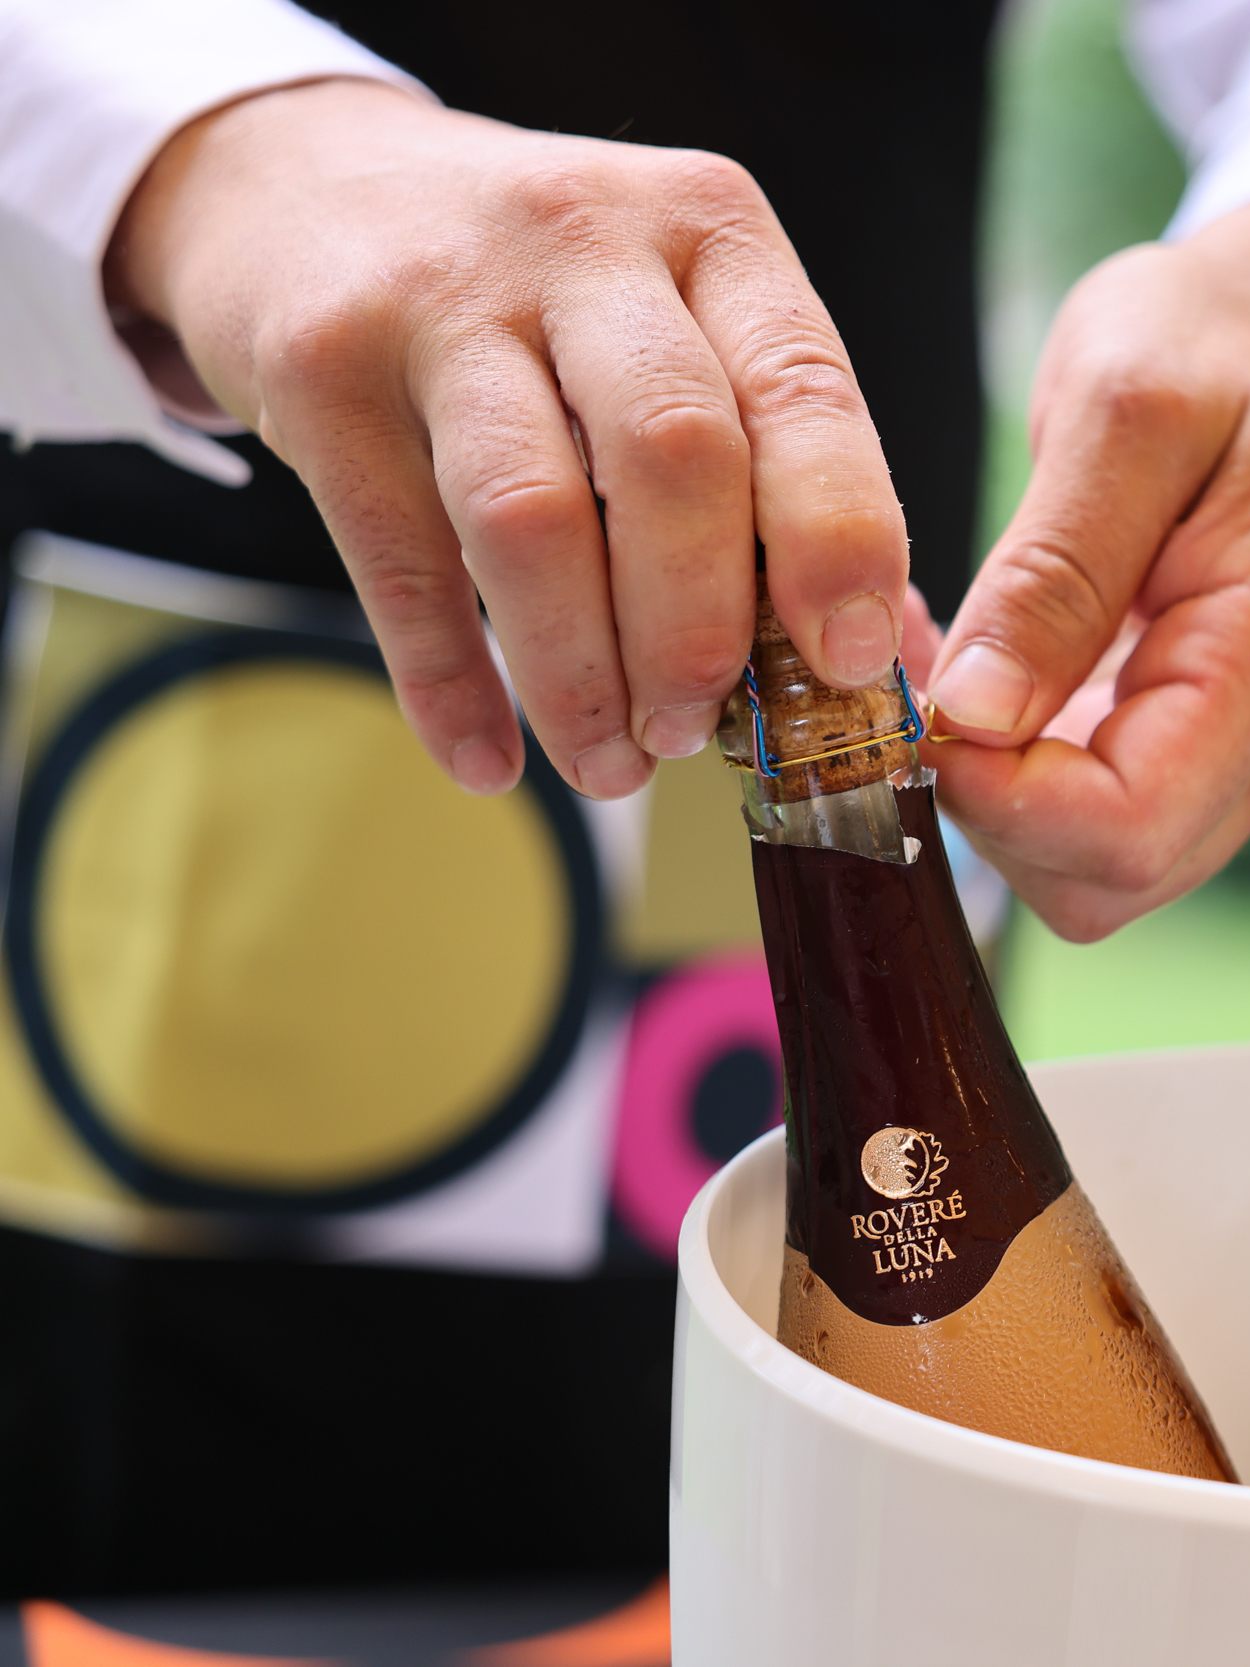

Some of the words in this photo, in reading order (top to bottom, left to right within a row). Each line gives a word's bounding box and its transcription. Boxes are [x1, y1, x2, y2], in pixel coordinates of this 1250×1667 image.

[851, 1190, 967, 1239] ROVERÉ
[884, 1226, 938, 1246] DELLA
[872, 1238, 956, 1274] LUNA
[902, 1268, 934, 1283] 1919
